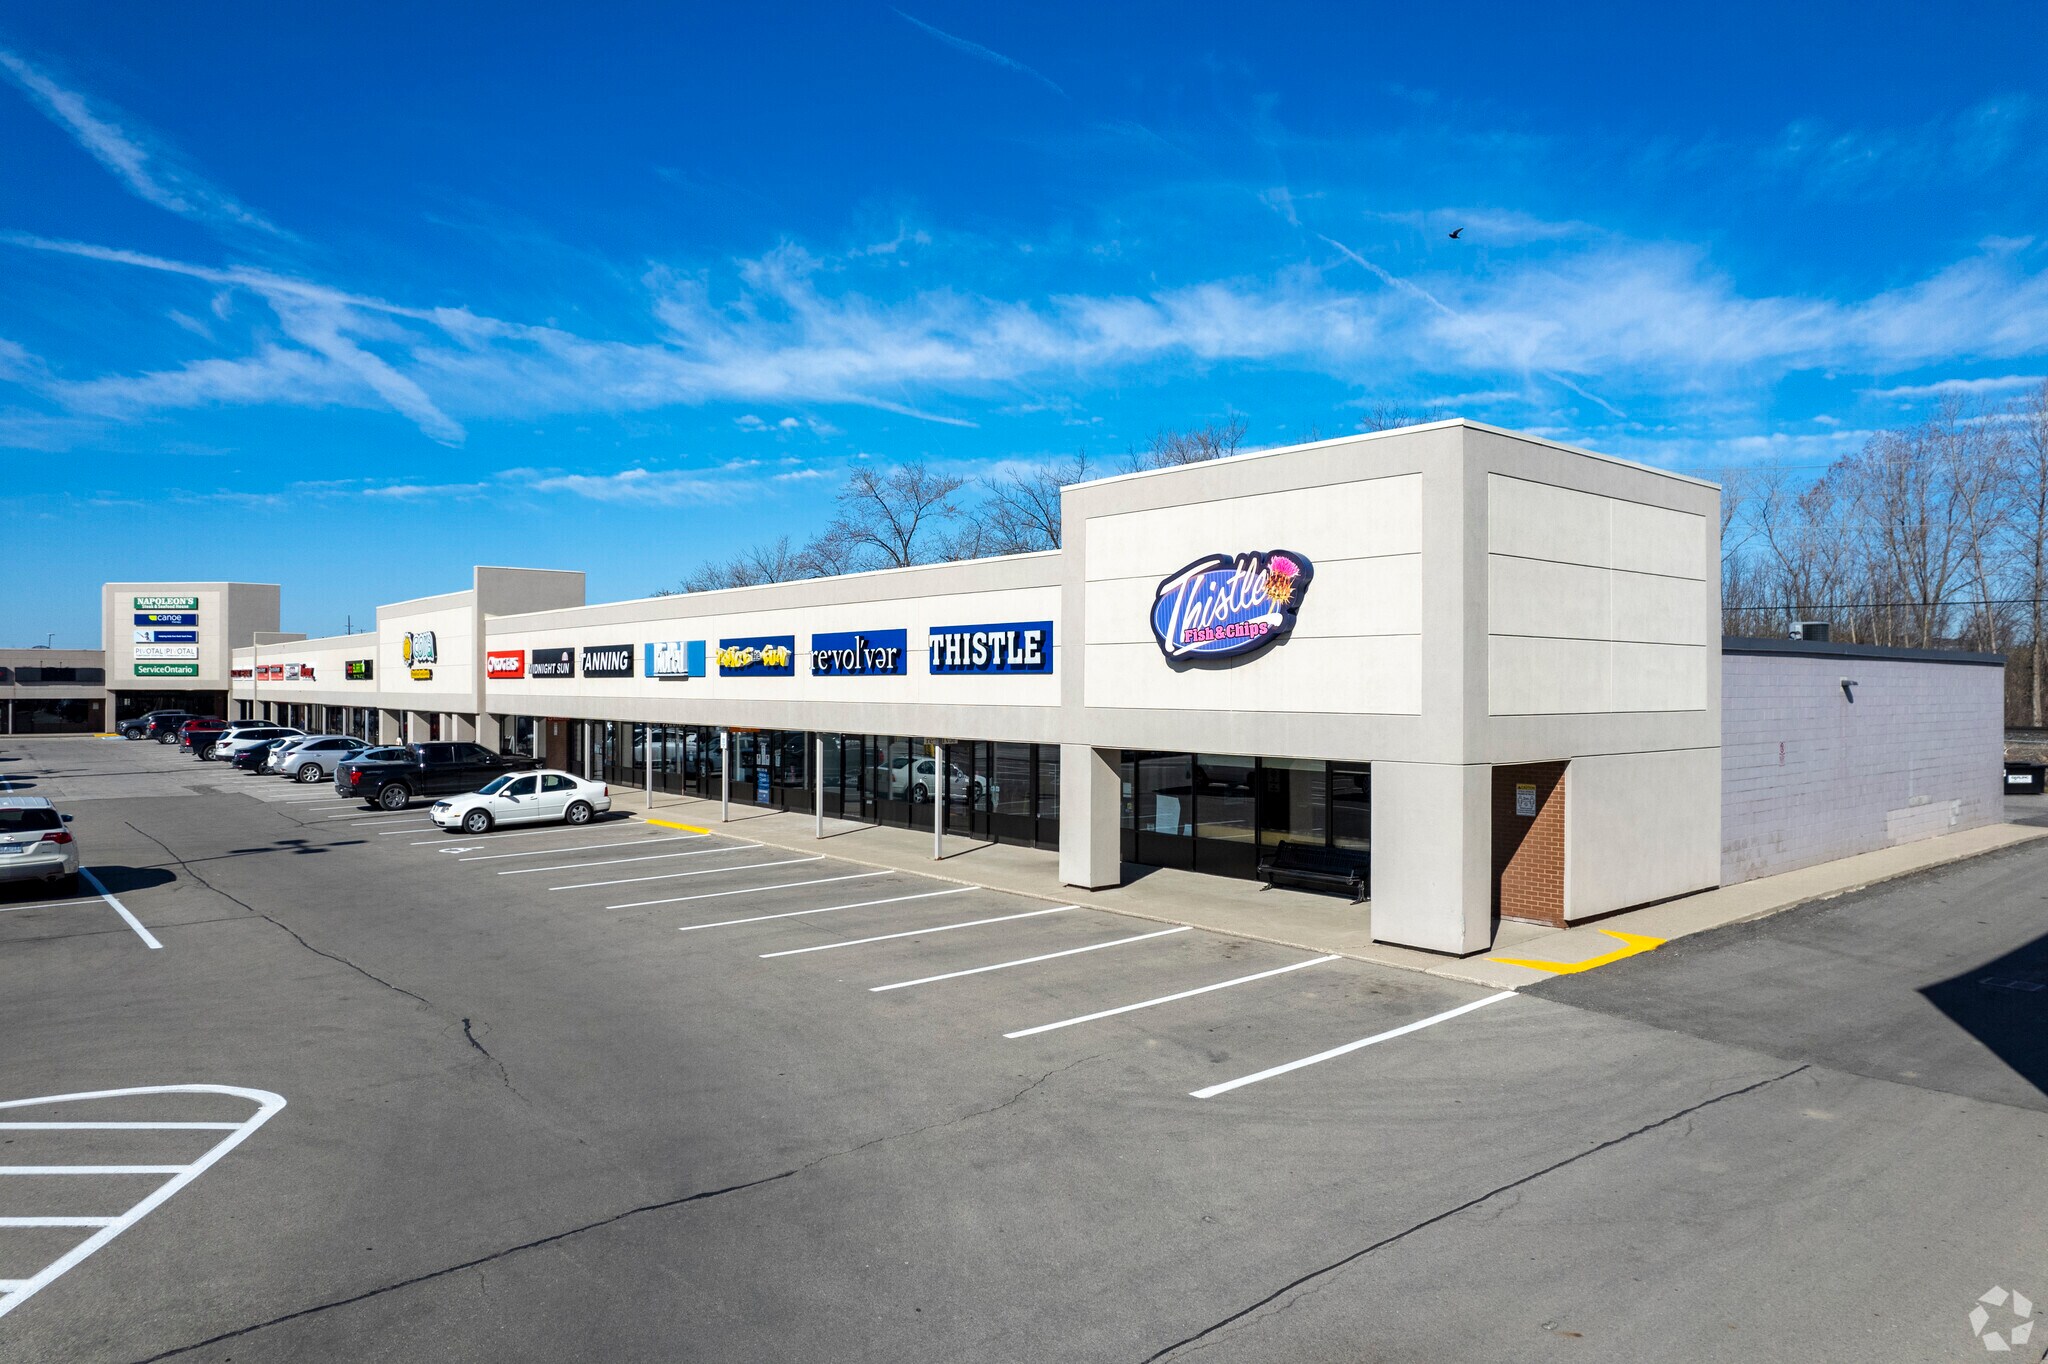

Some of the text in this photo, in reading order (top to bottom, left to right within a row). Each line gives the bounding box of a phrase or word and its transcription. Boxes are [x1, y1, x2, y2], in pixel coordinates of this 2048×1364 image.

[1160, 557, 1269, 654] Thistle
[580, 651, 628, 671] TANNING
[928, 630, 1041, 665] THISTLE
[529, 663, 570, 675] MIDNIGHT SUN
